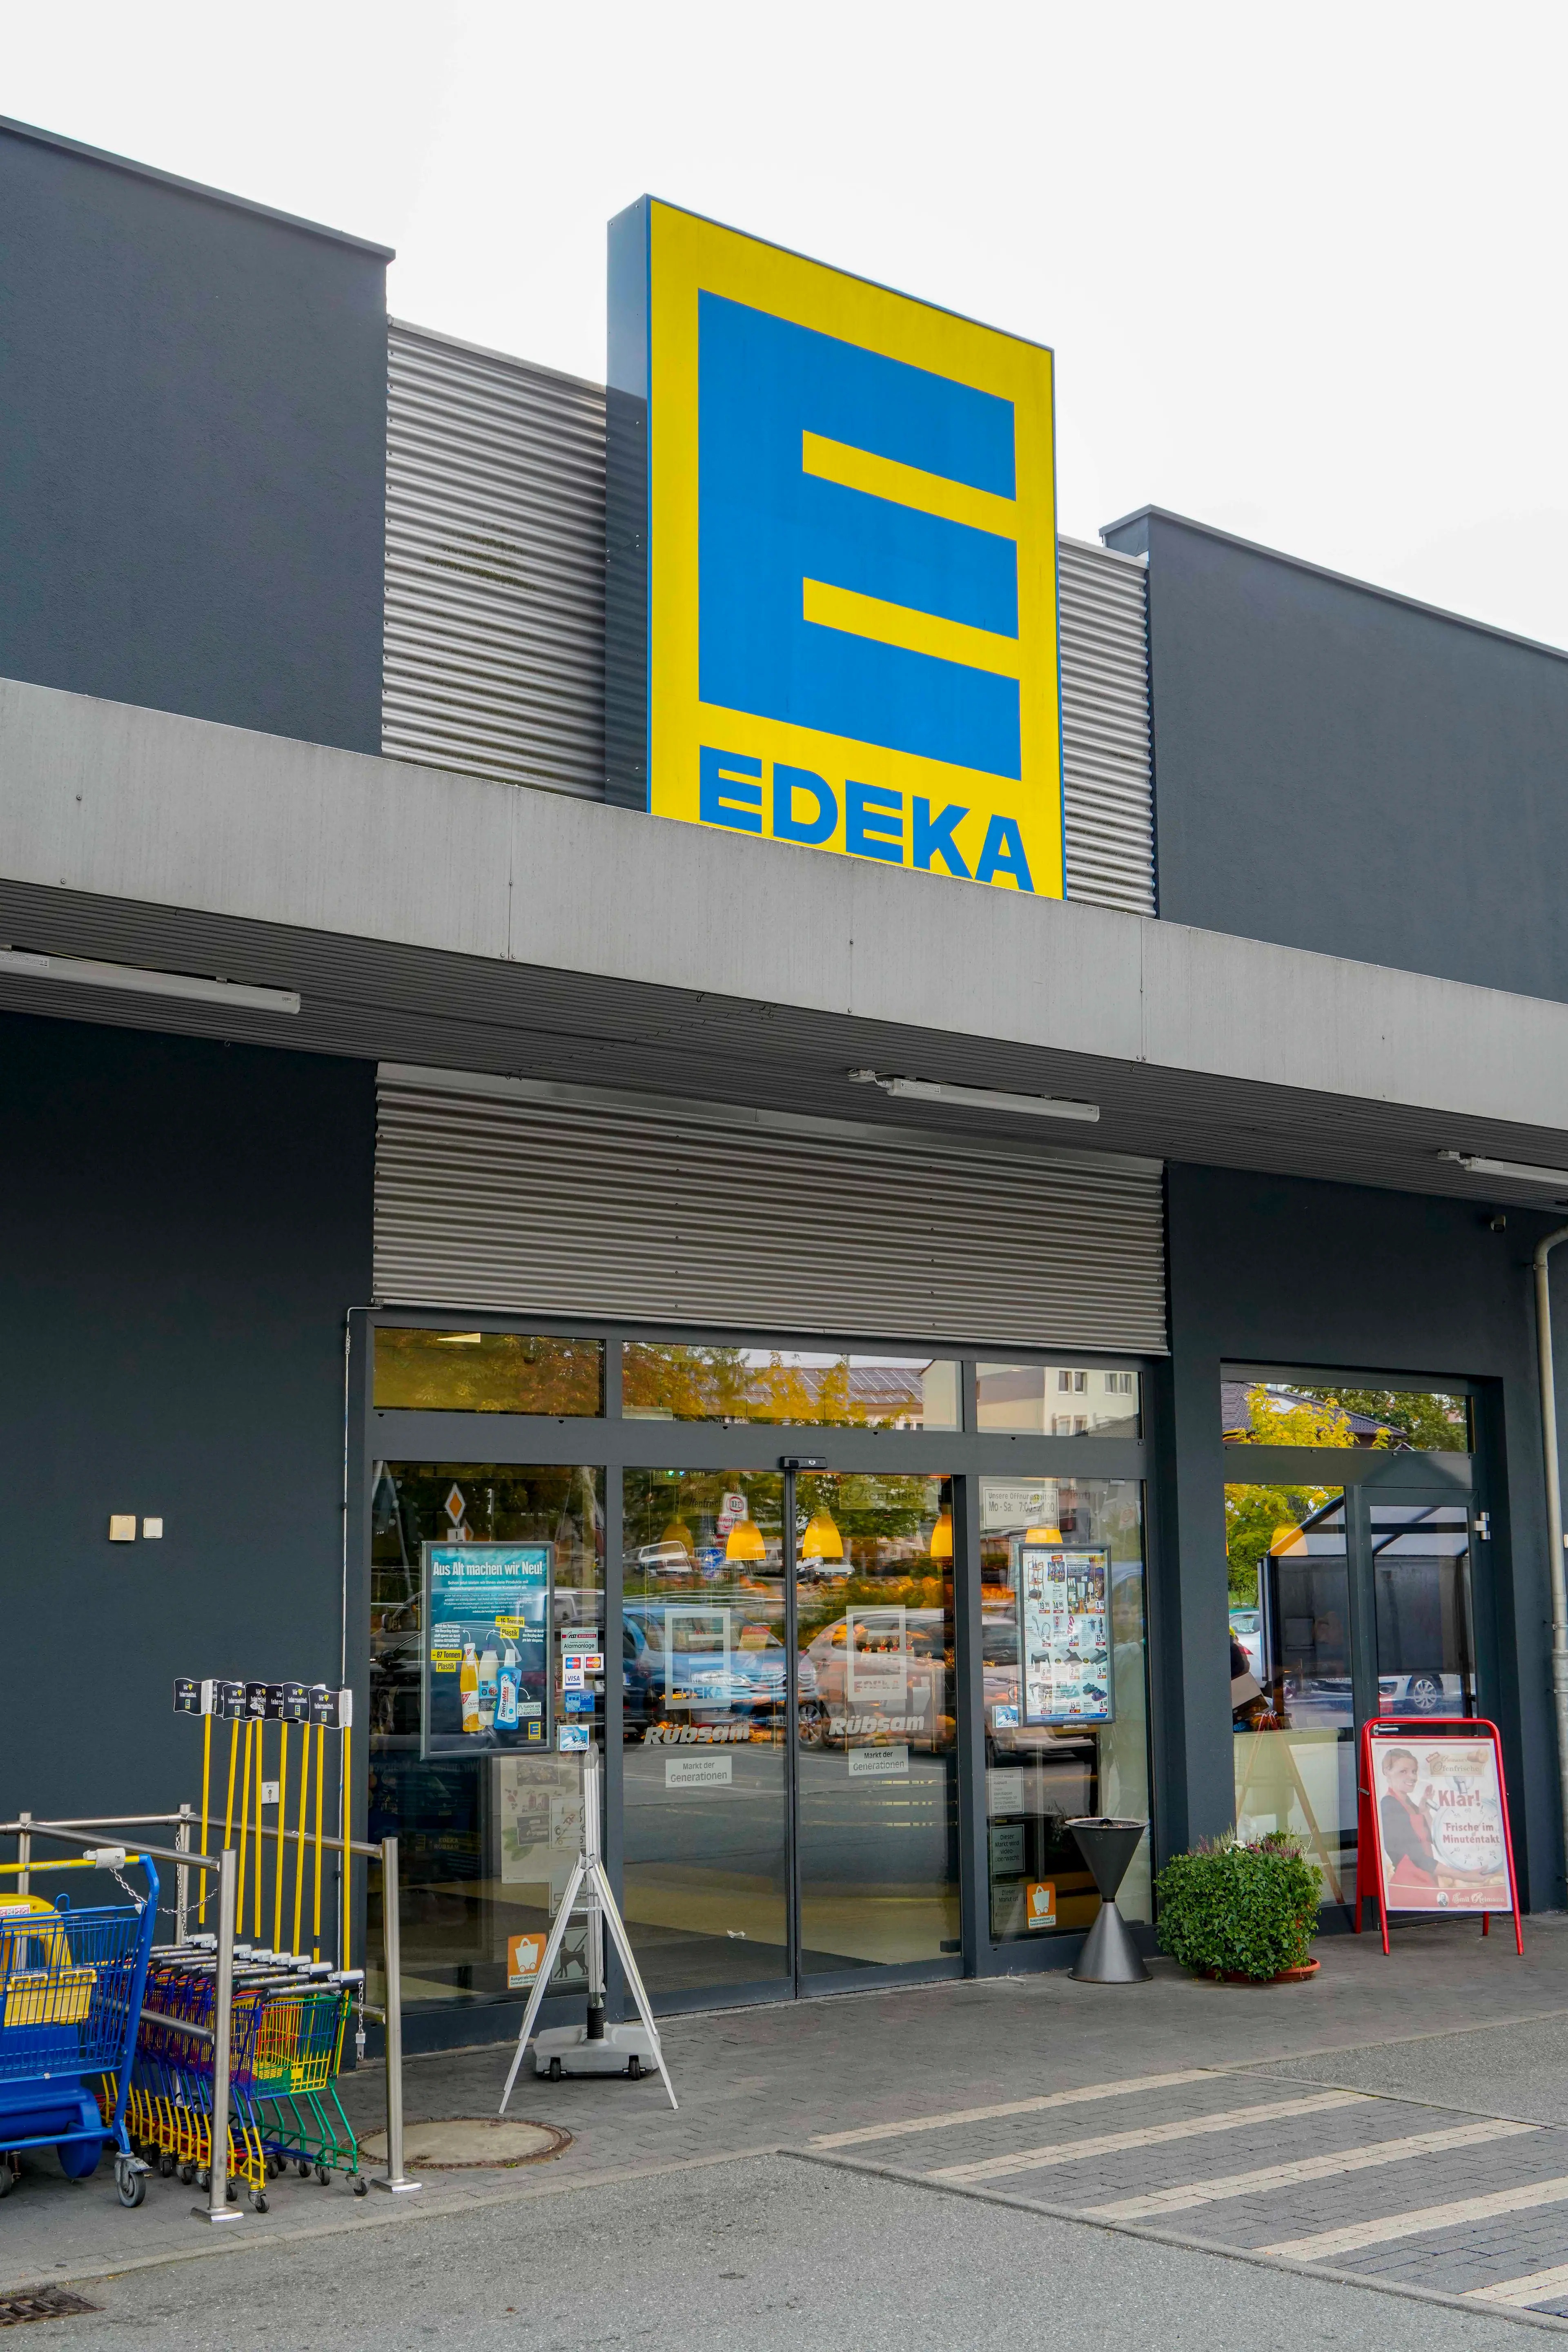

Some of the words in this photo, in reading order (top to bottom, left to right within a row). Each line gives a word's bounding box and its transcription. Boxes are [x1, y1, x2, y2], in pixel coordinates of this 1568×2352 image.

[699, 745, 1035, 893] EDEKA
[989, 1501, 998, 1511] Mo
[1004, 1501, 1013, 1511] Sa:
[1019, 1502, 1032, 1512] 7:00
[1037, 1502, 1055, 1512] 2100
[433, 1562, 450, 1576] Aus
[452, 1561, 464, 1576] Alt
[466, 1562, 502, 1575] machen
[504, 1561, 520, 1575] wir
[522, 1561, 543, 1575] Neu!
[672, 1686, 723, 1700] EDEKA
[828, 1715, 925, 1735] Rübsam
[643, 1724, 750, 1744] Rübsam
[1427, 1753, 1439, 1762] frisch
[853, 1760, 904, 1771] Generationen
[1432, 1761, 1479, 1773] Ofenfrische
[670, 1772, 727, 1783] Generationen
[1438, 1790, 1481, 1806] Klar!
[1446, 1822, 1479, 1832] Frische
[1482, 1822, 1494, 1831] im
[1443, 1834, 1500, 1844] Minutentakt
[1452, 1892, 1470, 1904] Emil
[1471, 1892, 1505, 1904] Reimann
